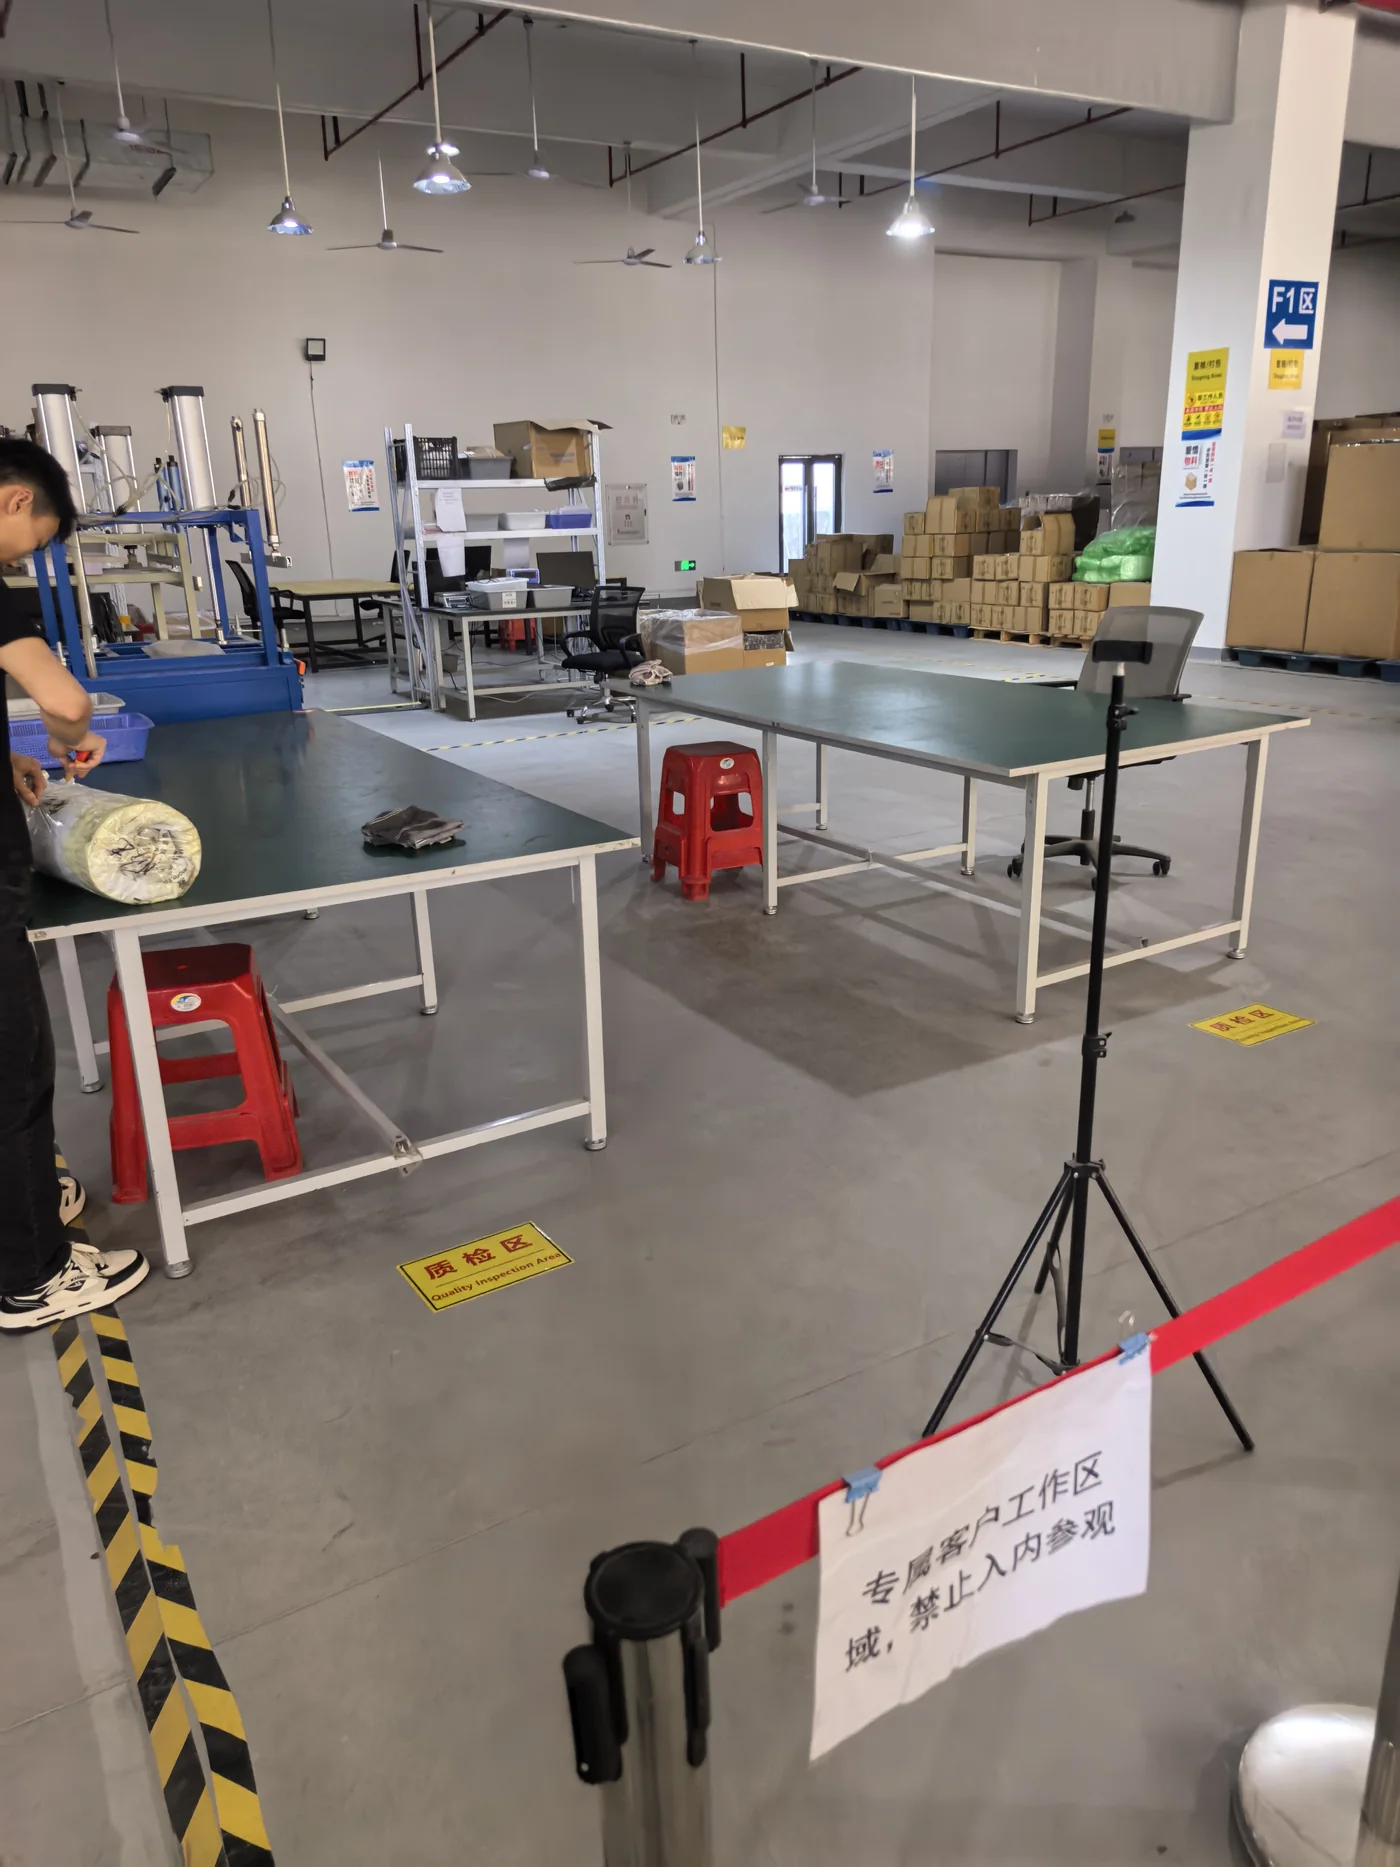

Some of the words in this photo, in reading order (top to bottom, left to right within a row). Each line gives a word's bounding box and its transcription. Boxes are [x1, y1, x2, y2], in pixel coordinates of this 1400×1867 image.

[1272, 286, 1315, 314] F1区
[1209, 1009, 1274, 1032] 质检区
[424, 1234, 533, 1280] 质检区
[431, 1282, 473, 1302] Quality
[475, 1261, 534, 1286] Inspection
[536, 1252, 562, 1265] Area
[862, 1451, 1103, 1604] 专属客户工作区
